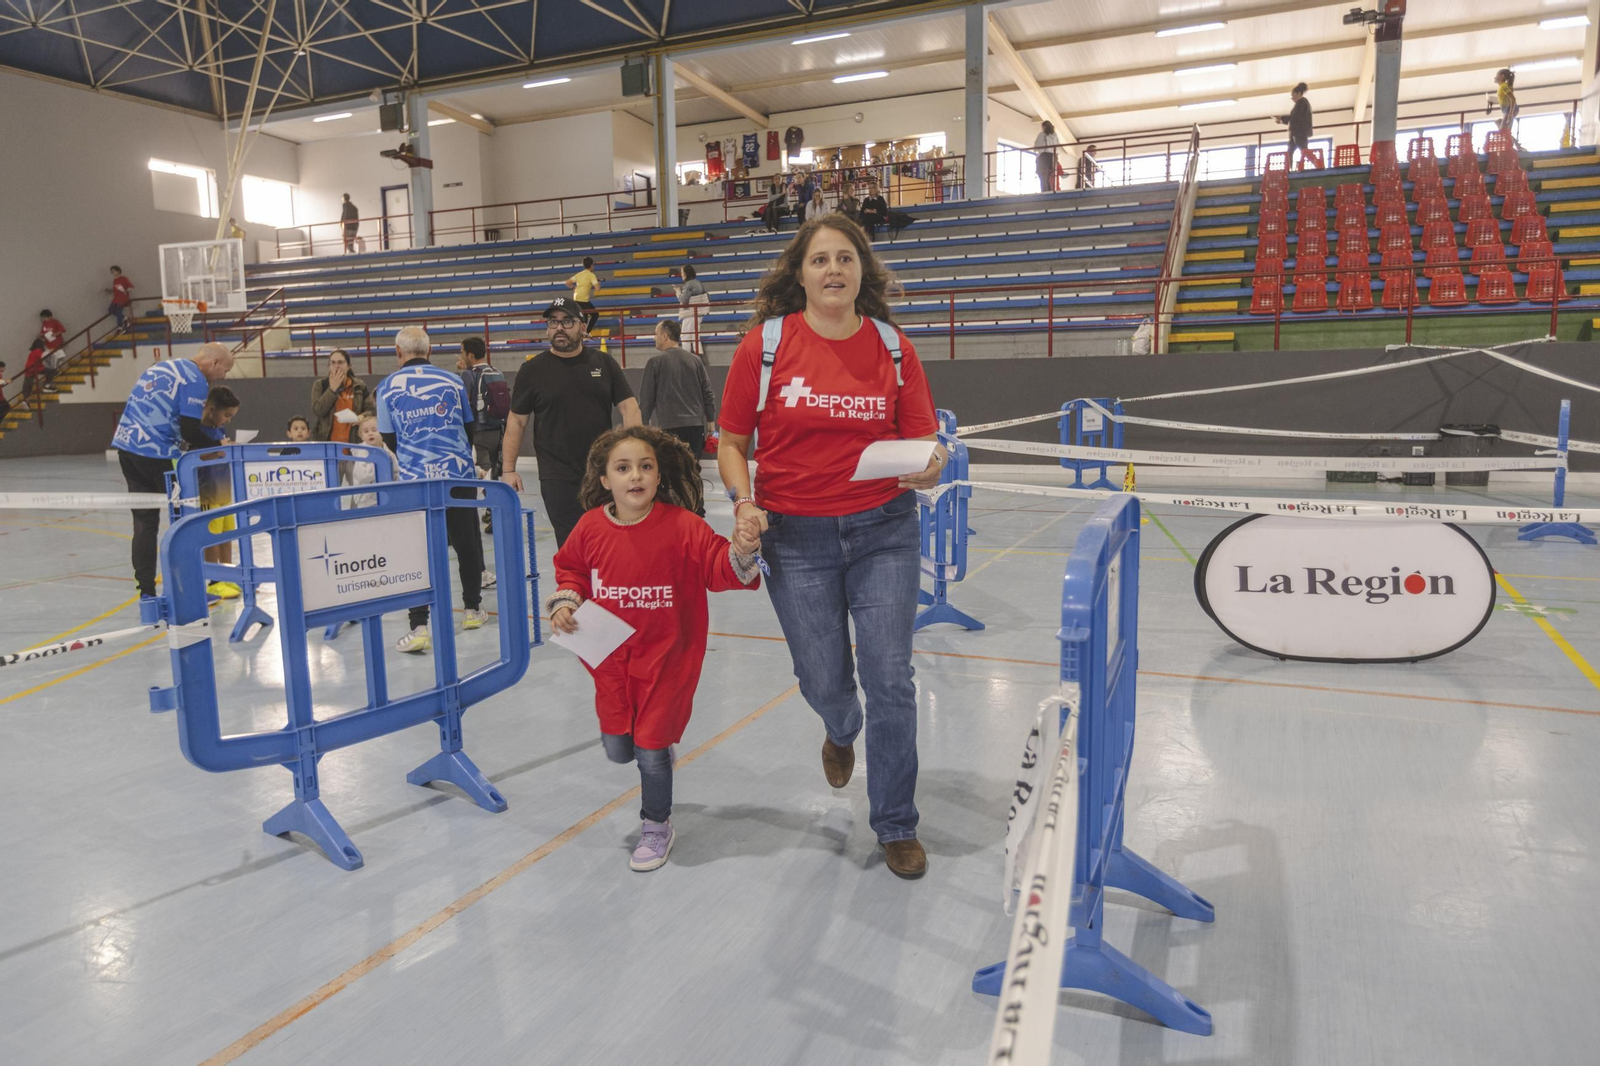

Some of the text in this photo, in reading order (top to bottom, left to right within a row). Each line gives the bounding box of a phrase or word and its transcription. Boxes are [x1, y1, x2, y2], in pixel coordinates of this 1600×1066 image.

[745, 143, 755, 152] 22
[806, 394, 886, 410] DEPORTE
[830, 409, 886, 421] La Región
[248, 467, 322, 482] ourense
[424, 462, 441, 473] TRIC
[1336, 505, 1357, 515] La
[1385, 505, 1467, 520] La Región
[1559, 512, 1581, 522] La
[334, 554, 387, 575] inorde
[337, 571, 422, 594] turismo Ourense
[1234, 565, 1457, 604] La Región
[600, 585, 673, 599] DEPORTE
[620, 599, 673, 610] La Región
